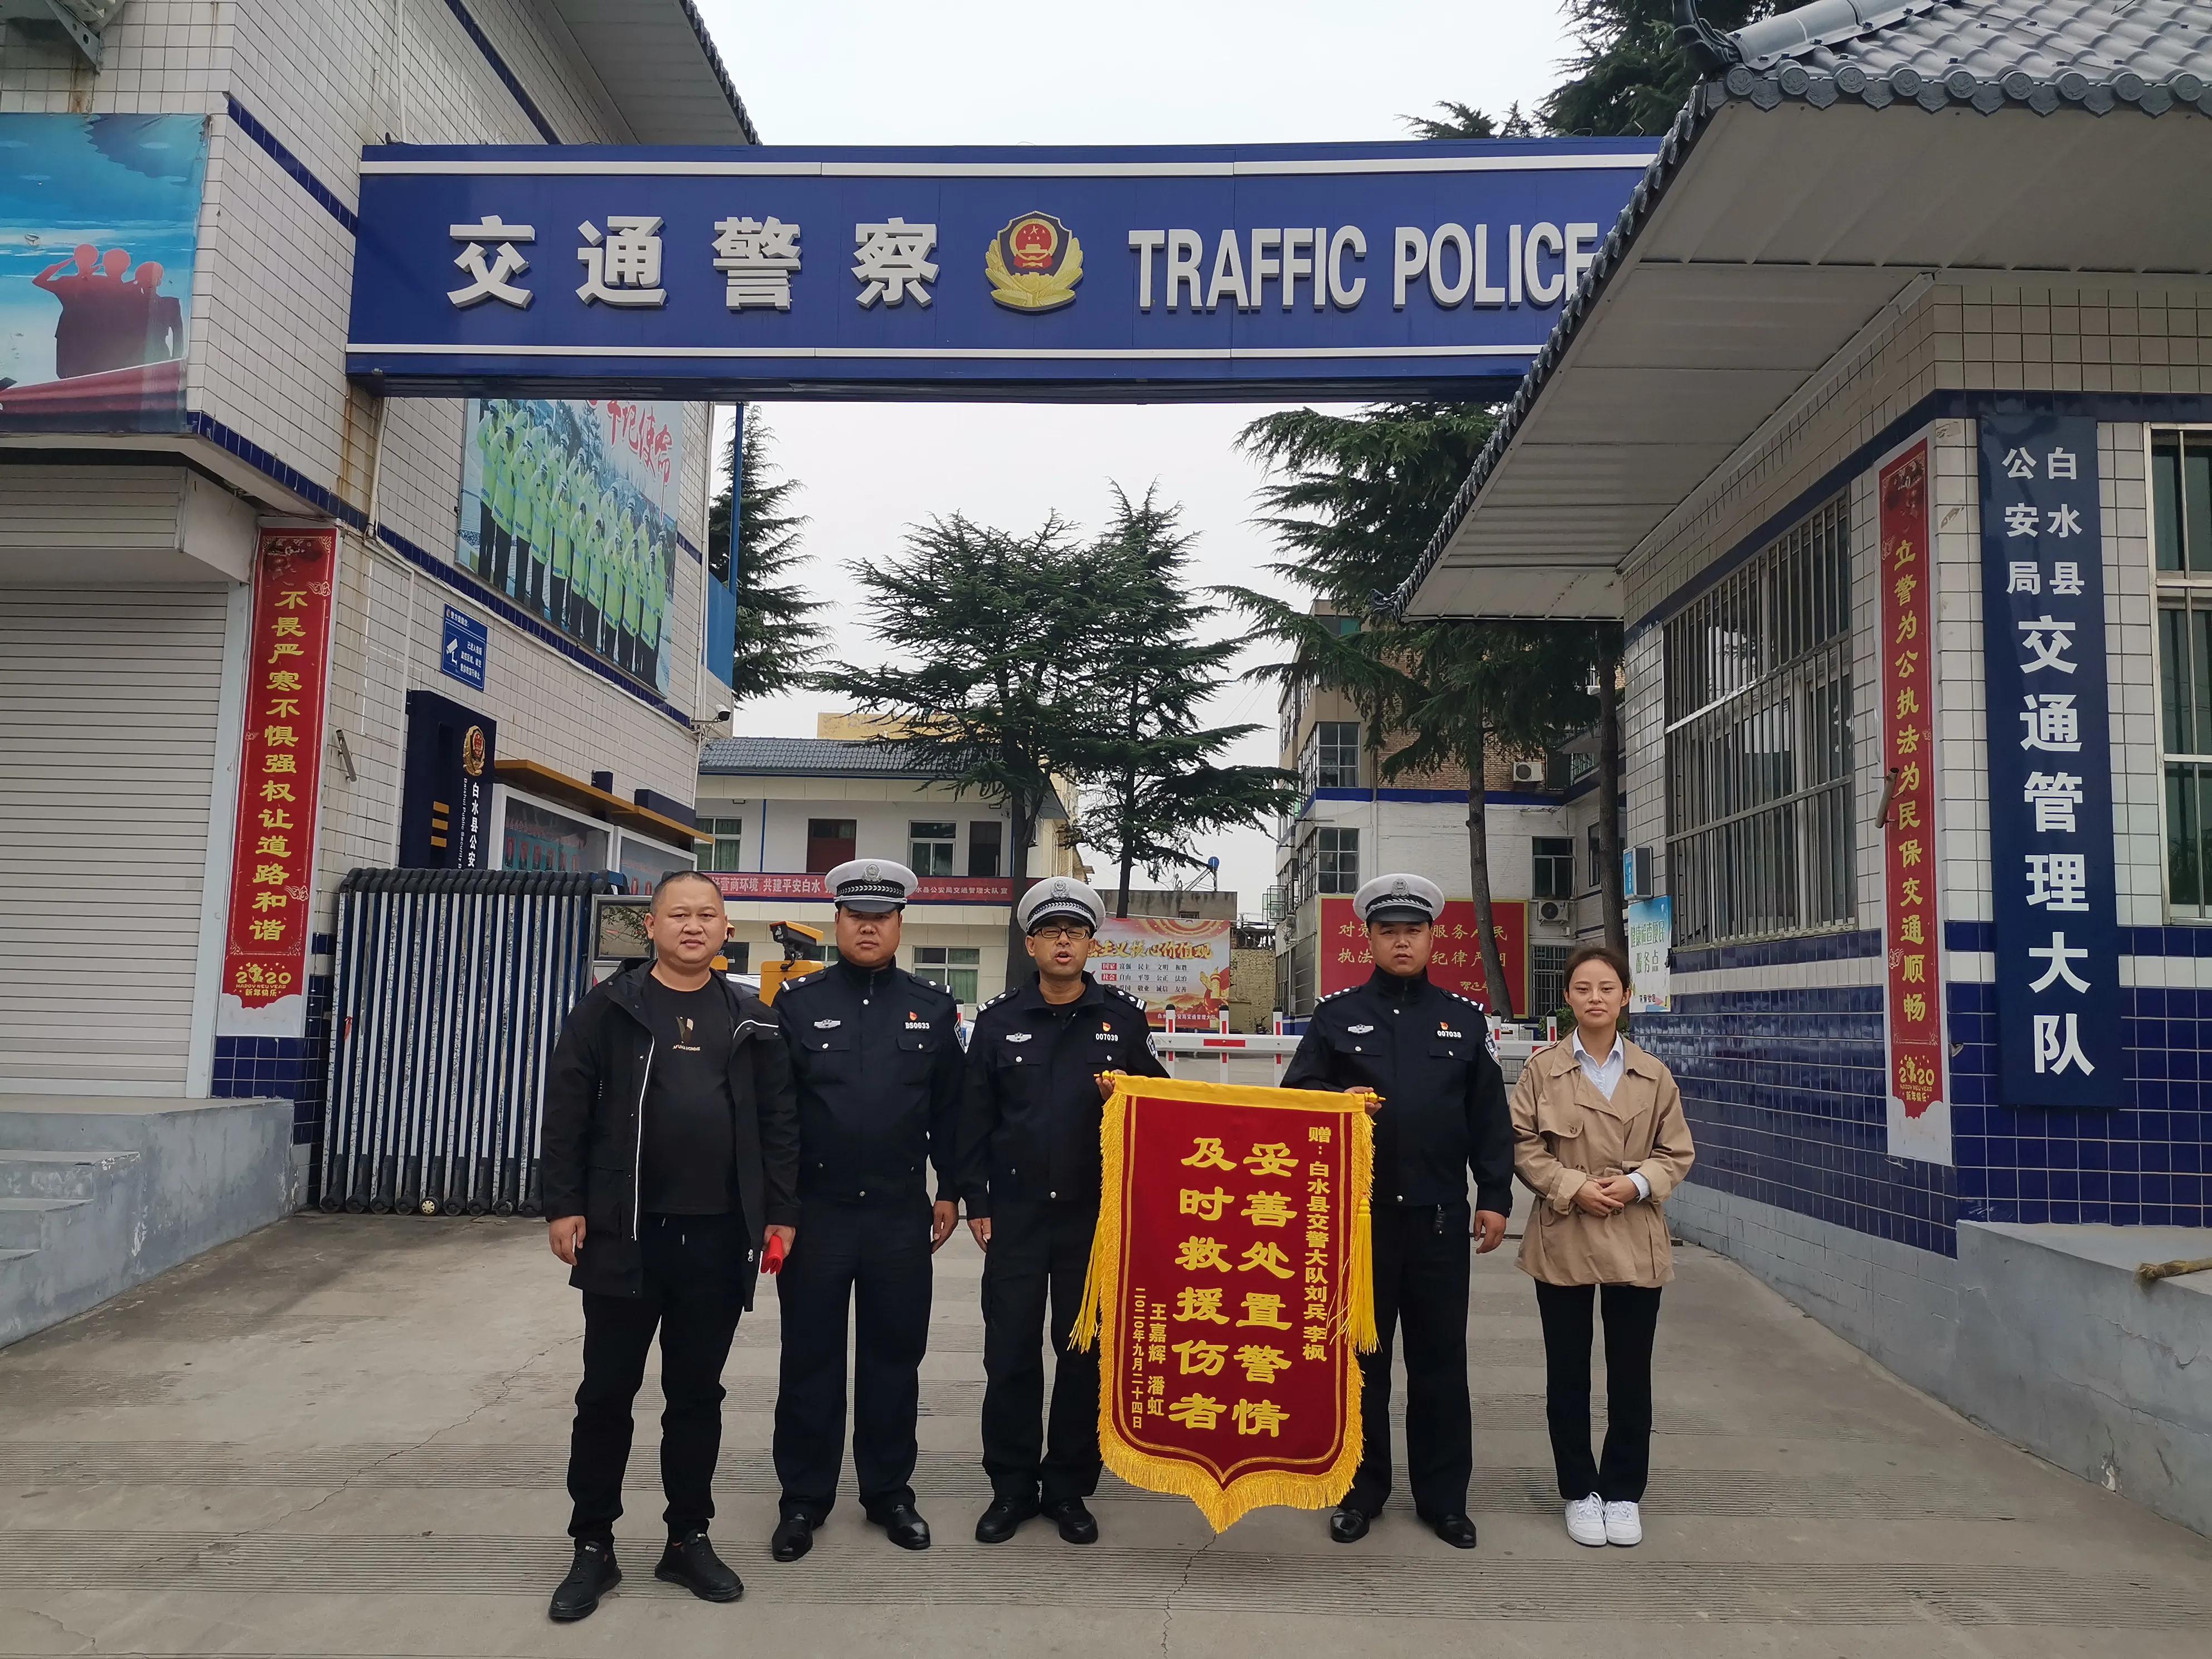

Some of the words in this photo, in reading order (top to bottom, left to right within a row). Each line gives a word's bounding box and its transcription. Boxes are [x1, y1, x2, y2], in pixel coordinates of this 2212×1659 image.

[447, 215, 940, 310] 交通警察
[1128, 225, 1367, 311] TRAFFIC
[2001, 447, 2041, 595] 公安局
[2047, 447, 2085, 596] 白水县
[249, 591, 308, 942] 不畏严寒不惧强权让道路和谐
[468, 782, 479, 867] 白水县公安
[1894, 539, 1927, 1022] 立警为公执法为民保交通顺畅
[763, 878, 821, 893] 共建平安白水
[2019, 615, 2095, 1076] 交通管理大队
[1095, 1033, 1119, 1041] 007039
[1168, 1137, 1238, 1430] 及时救援伤者
[1231, 1142, 1299, 1438] 妥善处置警情
